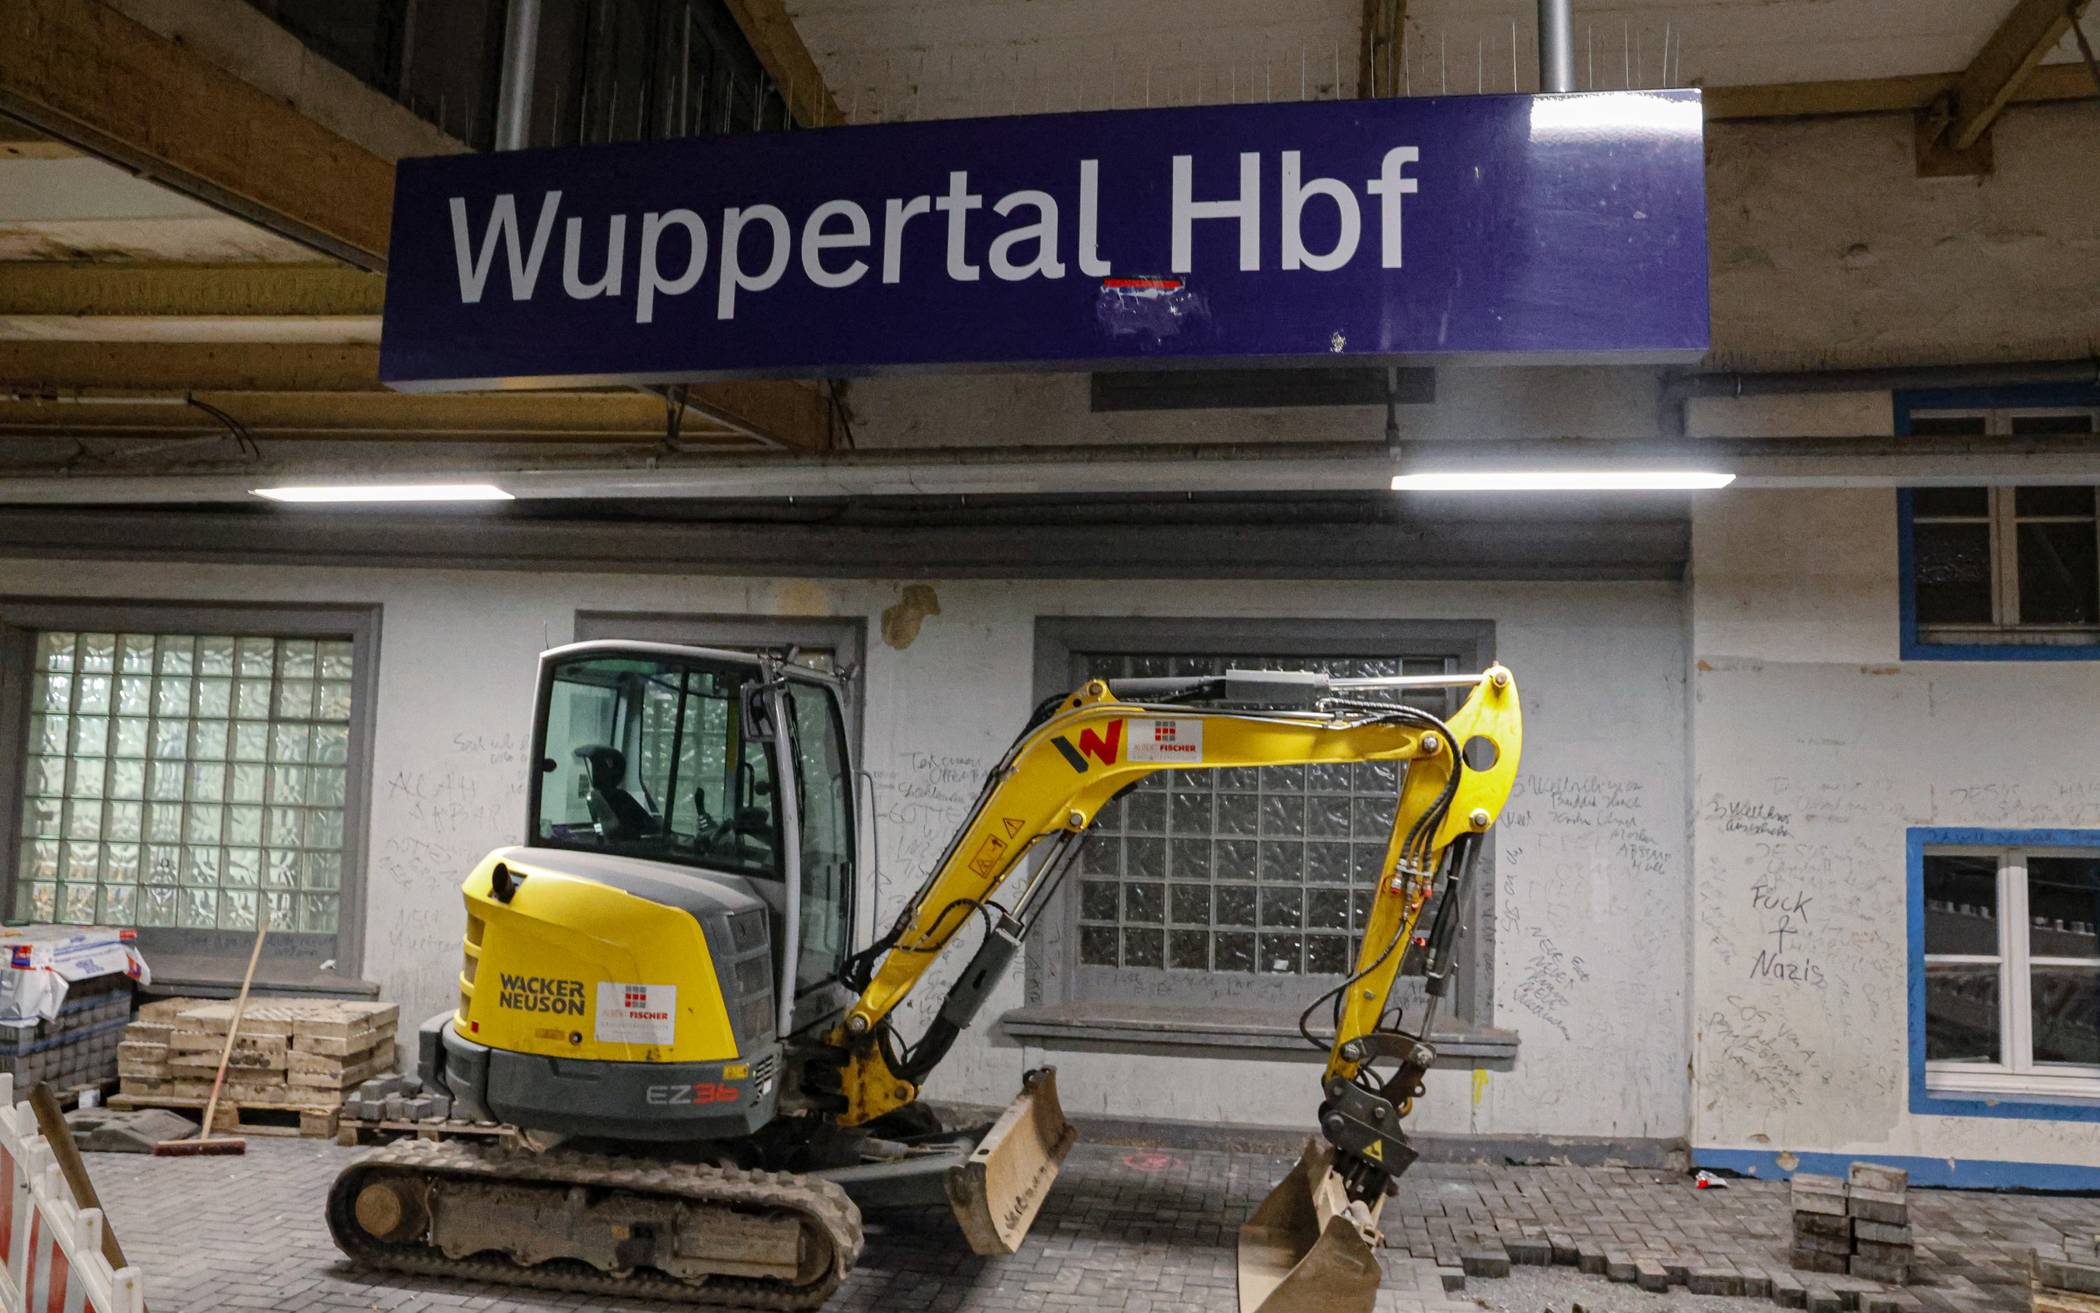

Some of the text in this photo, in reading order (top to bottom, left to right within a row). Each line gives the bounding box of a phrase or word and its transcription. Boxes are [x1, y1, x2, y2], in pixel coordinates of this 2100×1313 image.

[448, 145, 1421, 325] Wuppertal Hbf
[1159, 744, 1197, 753] FISCHER
[1748, 949, 1825, 985] Nazis
[499, 972, 586, 998] WACKER
[499, 992, 586, 1016] NEUSON
[629, 1011, 669, 1020] FISCHER
[645, 1082, 740, 1105] EZ36
